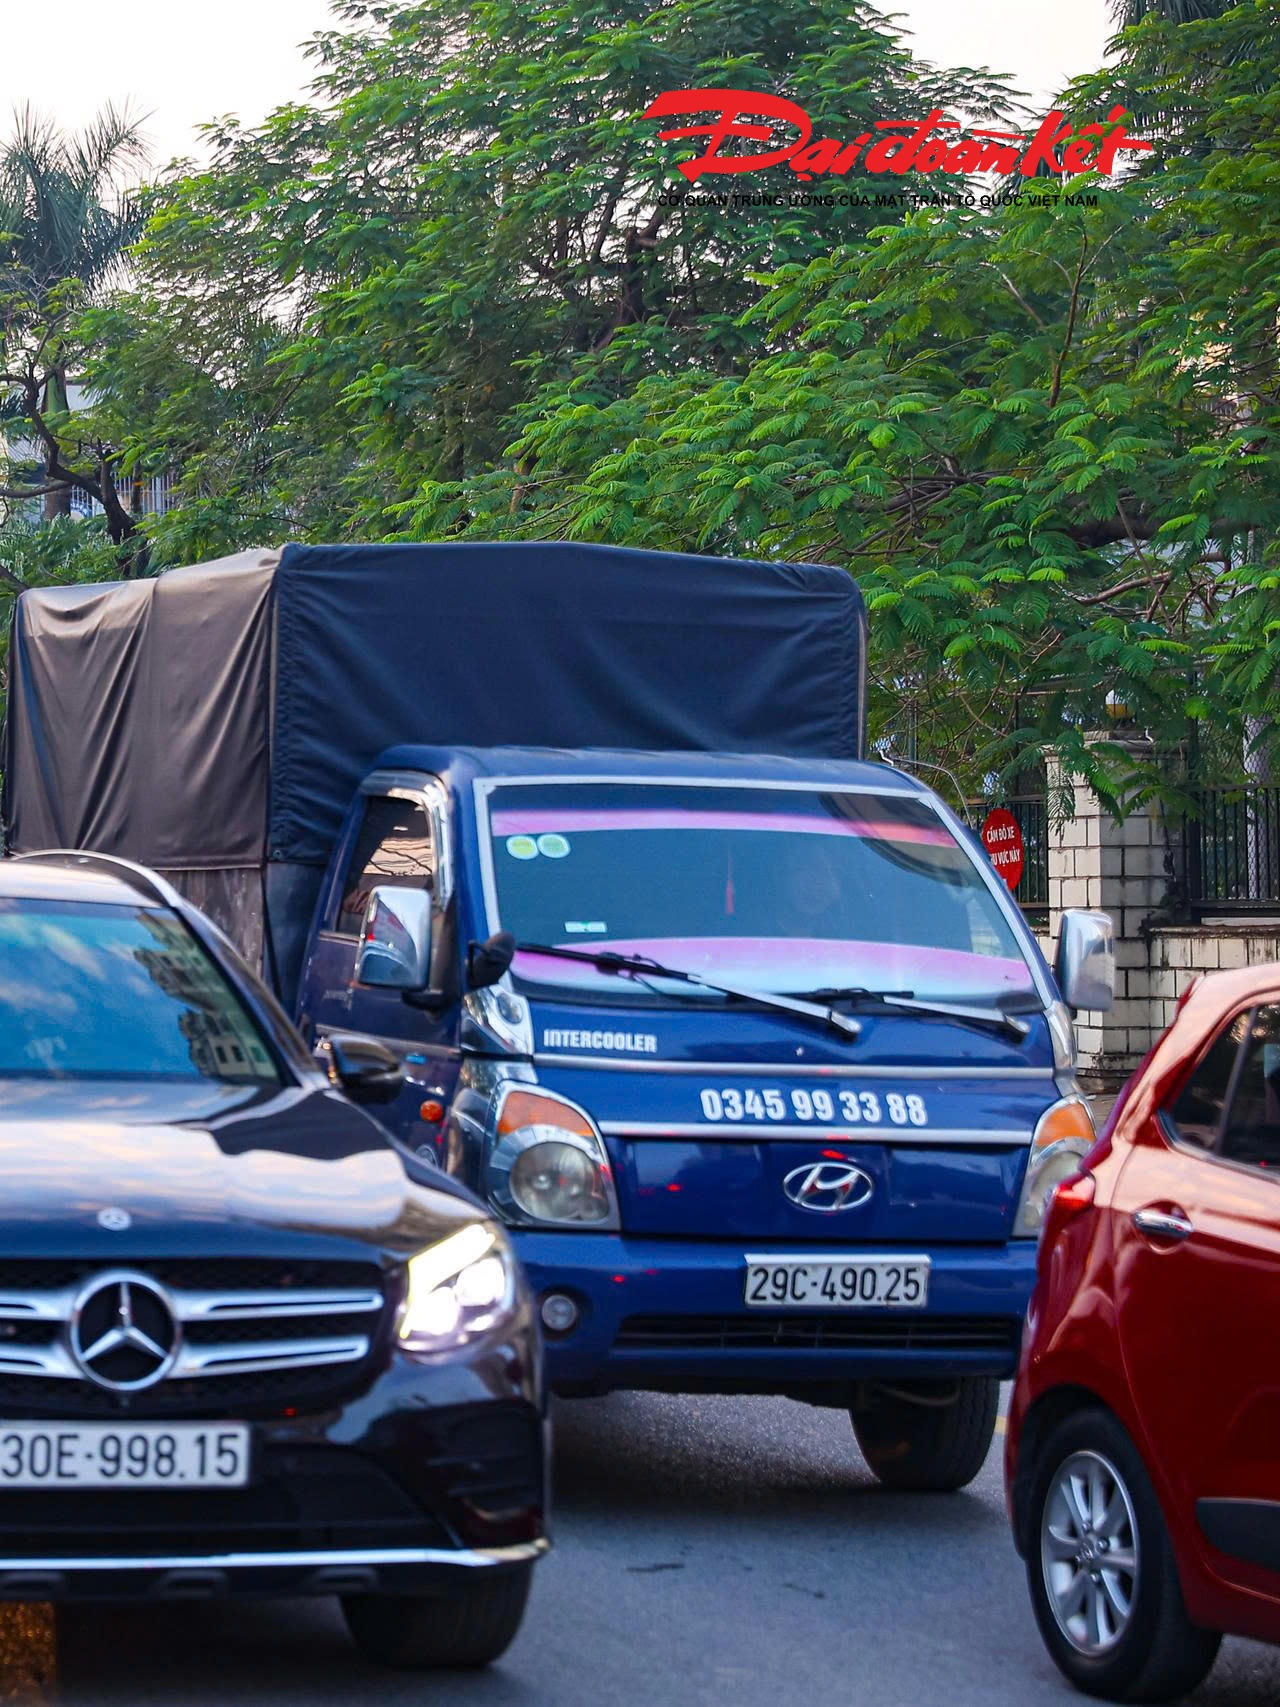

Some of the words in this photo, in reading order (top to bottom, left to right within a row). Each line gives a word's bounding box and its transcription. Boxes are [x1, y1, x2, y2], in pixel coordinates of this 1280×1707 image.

[1007, 826, 1015, 840] XE
[543, 1029, 658, 1053] INTERCOOLER
[700, 1088, 787, 1121] 0345
[790, 1088, 836, 1121] 99
[838, 1090, 883, 1123] 33
[885, 1092, 929, 1126] 88
[750, 1267, 920, 1301] 29C-490.25
[1, 1434, 239, 1478] 30E-998.15
